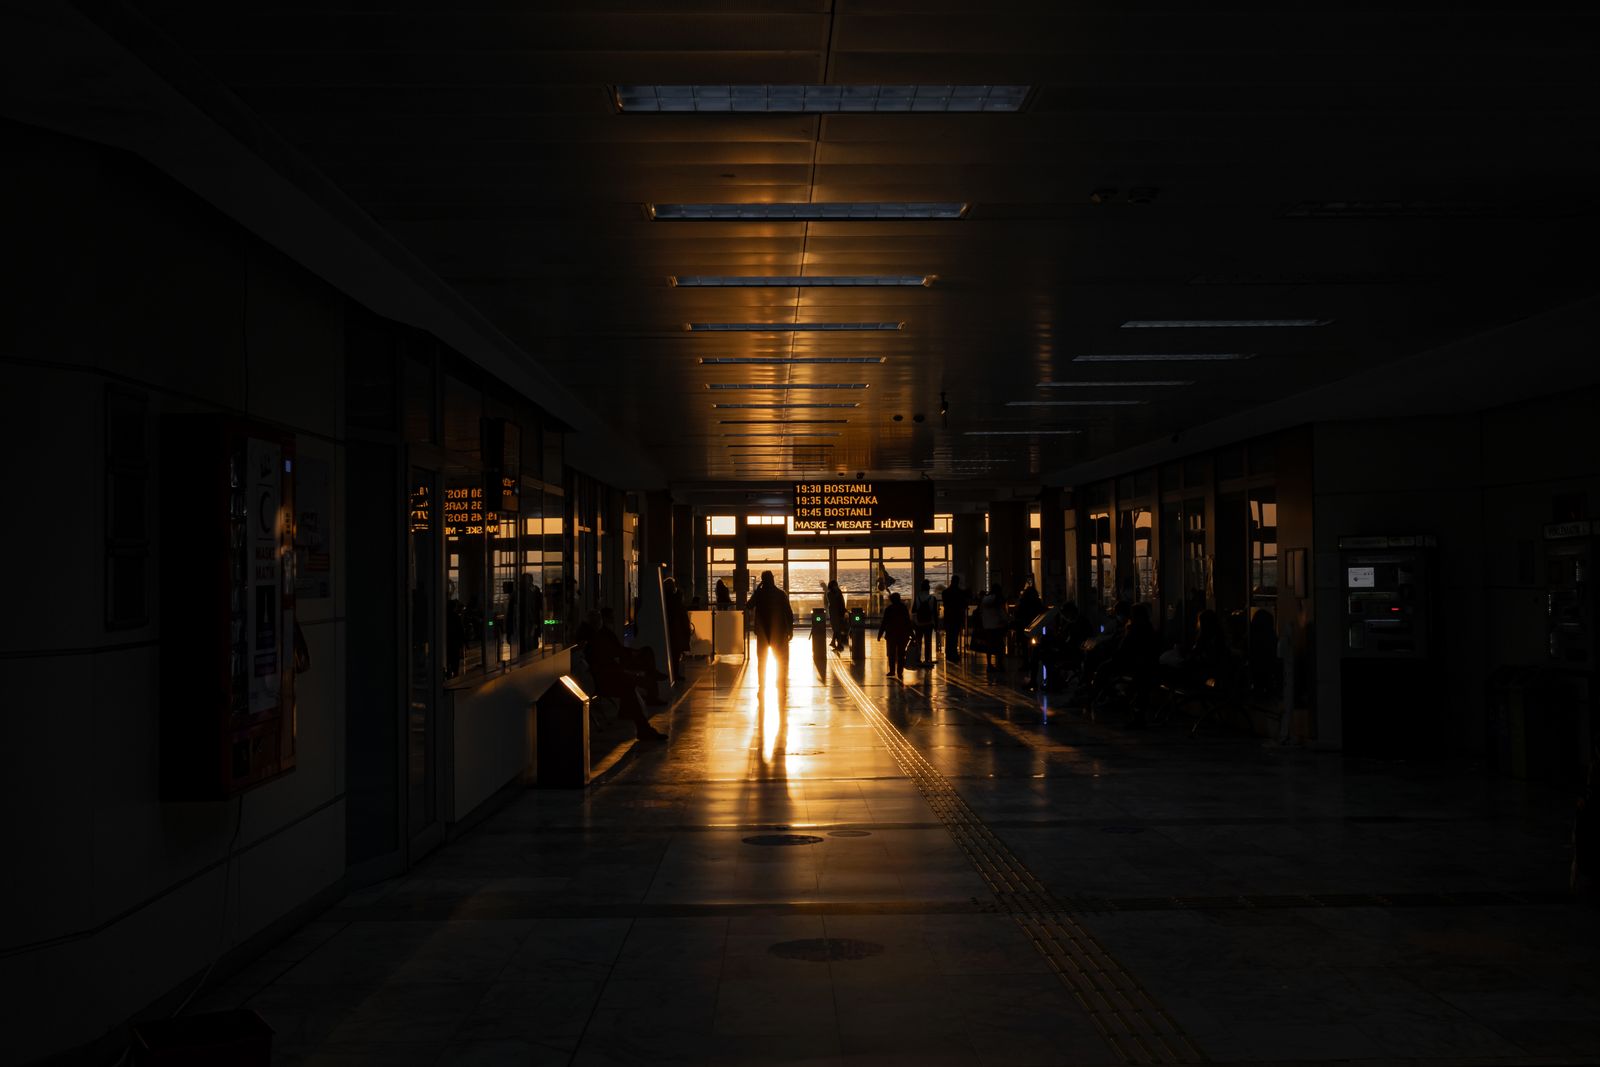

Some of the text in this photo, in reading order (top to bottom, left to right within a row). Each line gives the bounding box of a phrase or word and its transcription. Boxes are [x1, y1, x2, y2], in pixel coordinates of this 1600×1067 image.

[796, 484, 872, 493] 19:30 BOSTANLI
[796, 496, 822, 505] 19:35
[796, 508, 872, 517] 19:45 BOSTANLI
[795, 520, 828, 529] MASKE
[836, 520, 872, 529] MESAFE
